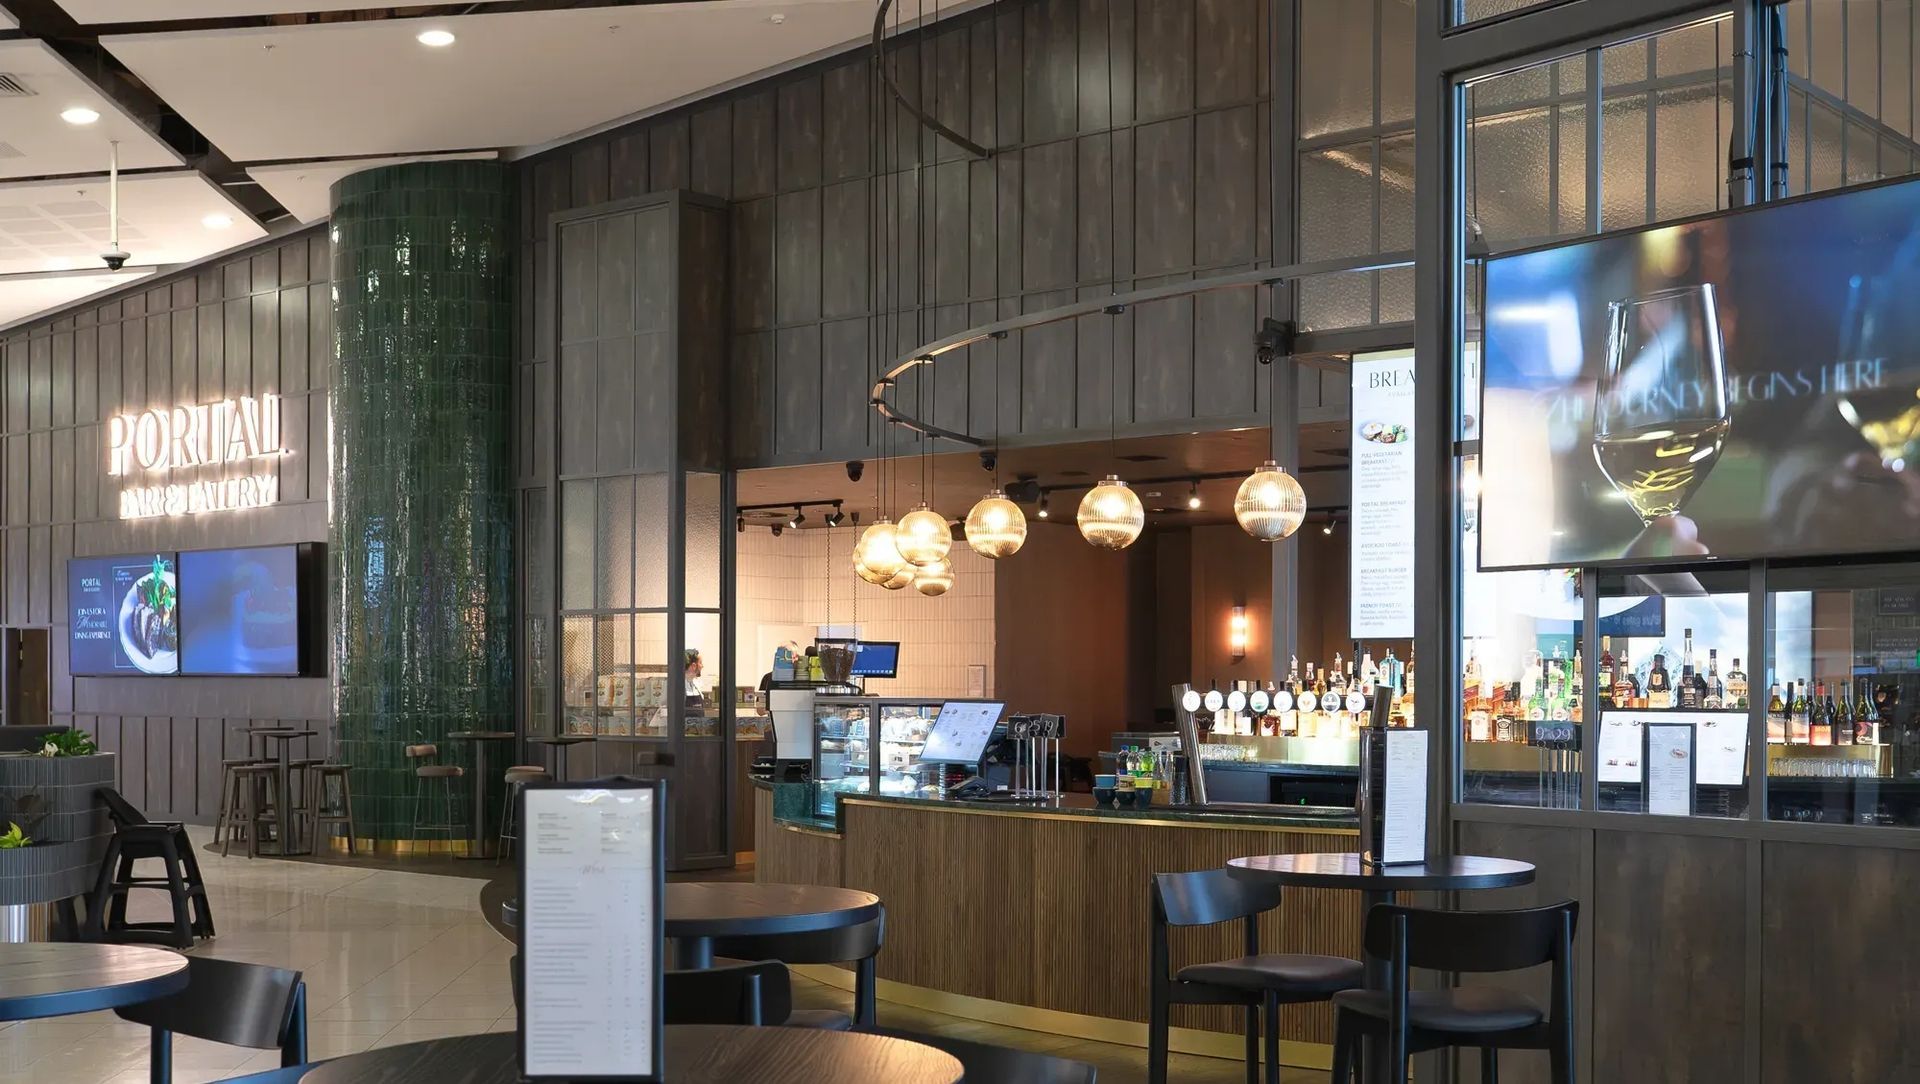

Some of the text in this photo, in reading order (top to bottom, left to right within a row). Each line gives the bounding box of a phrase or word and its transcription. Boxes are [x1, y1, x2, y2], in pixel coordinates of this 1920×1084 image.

[1820, 357, 1888, 394] HERE
[107, 393, 288, 476] PORTAL
[120, 475, 278, 519] BAR & EATERY
[81, 577, 102, 588] PORTAL
[1536, 727, 1571, 743] 9 29
